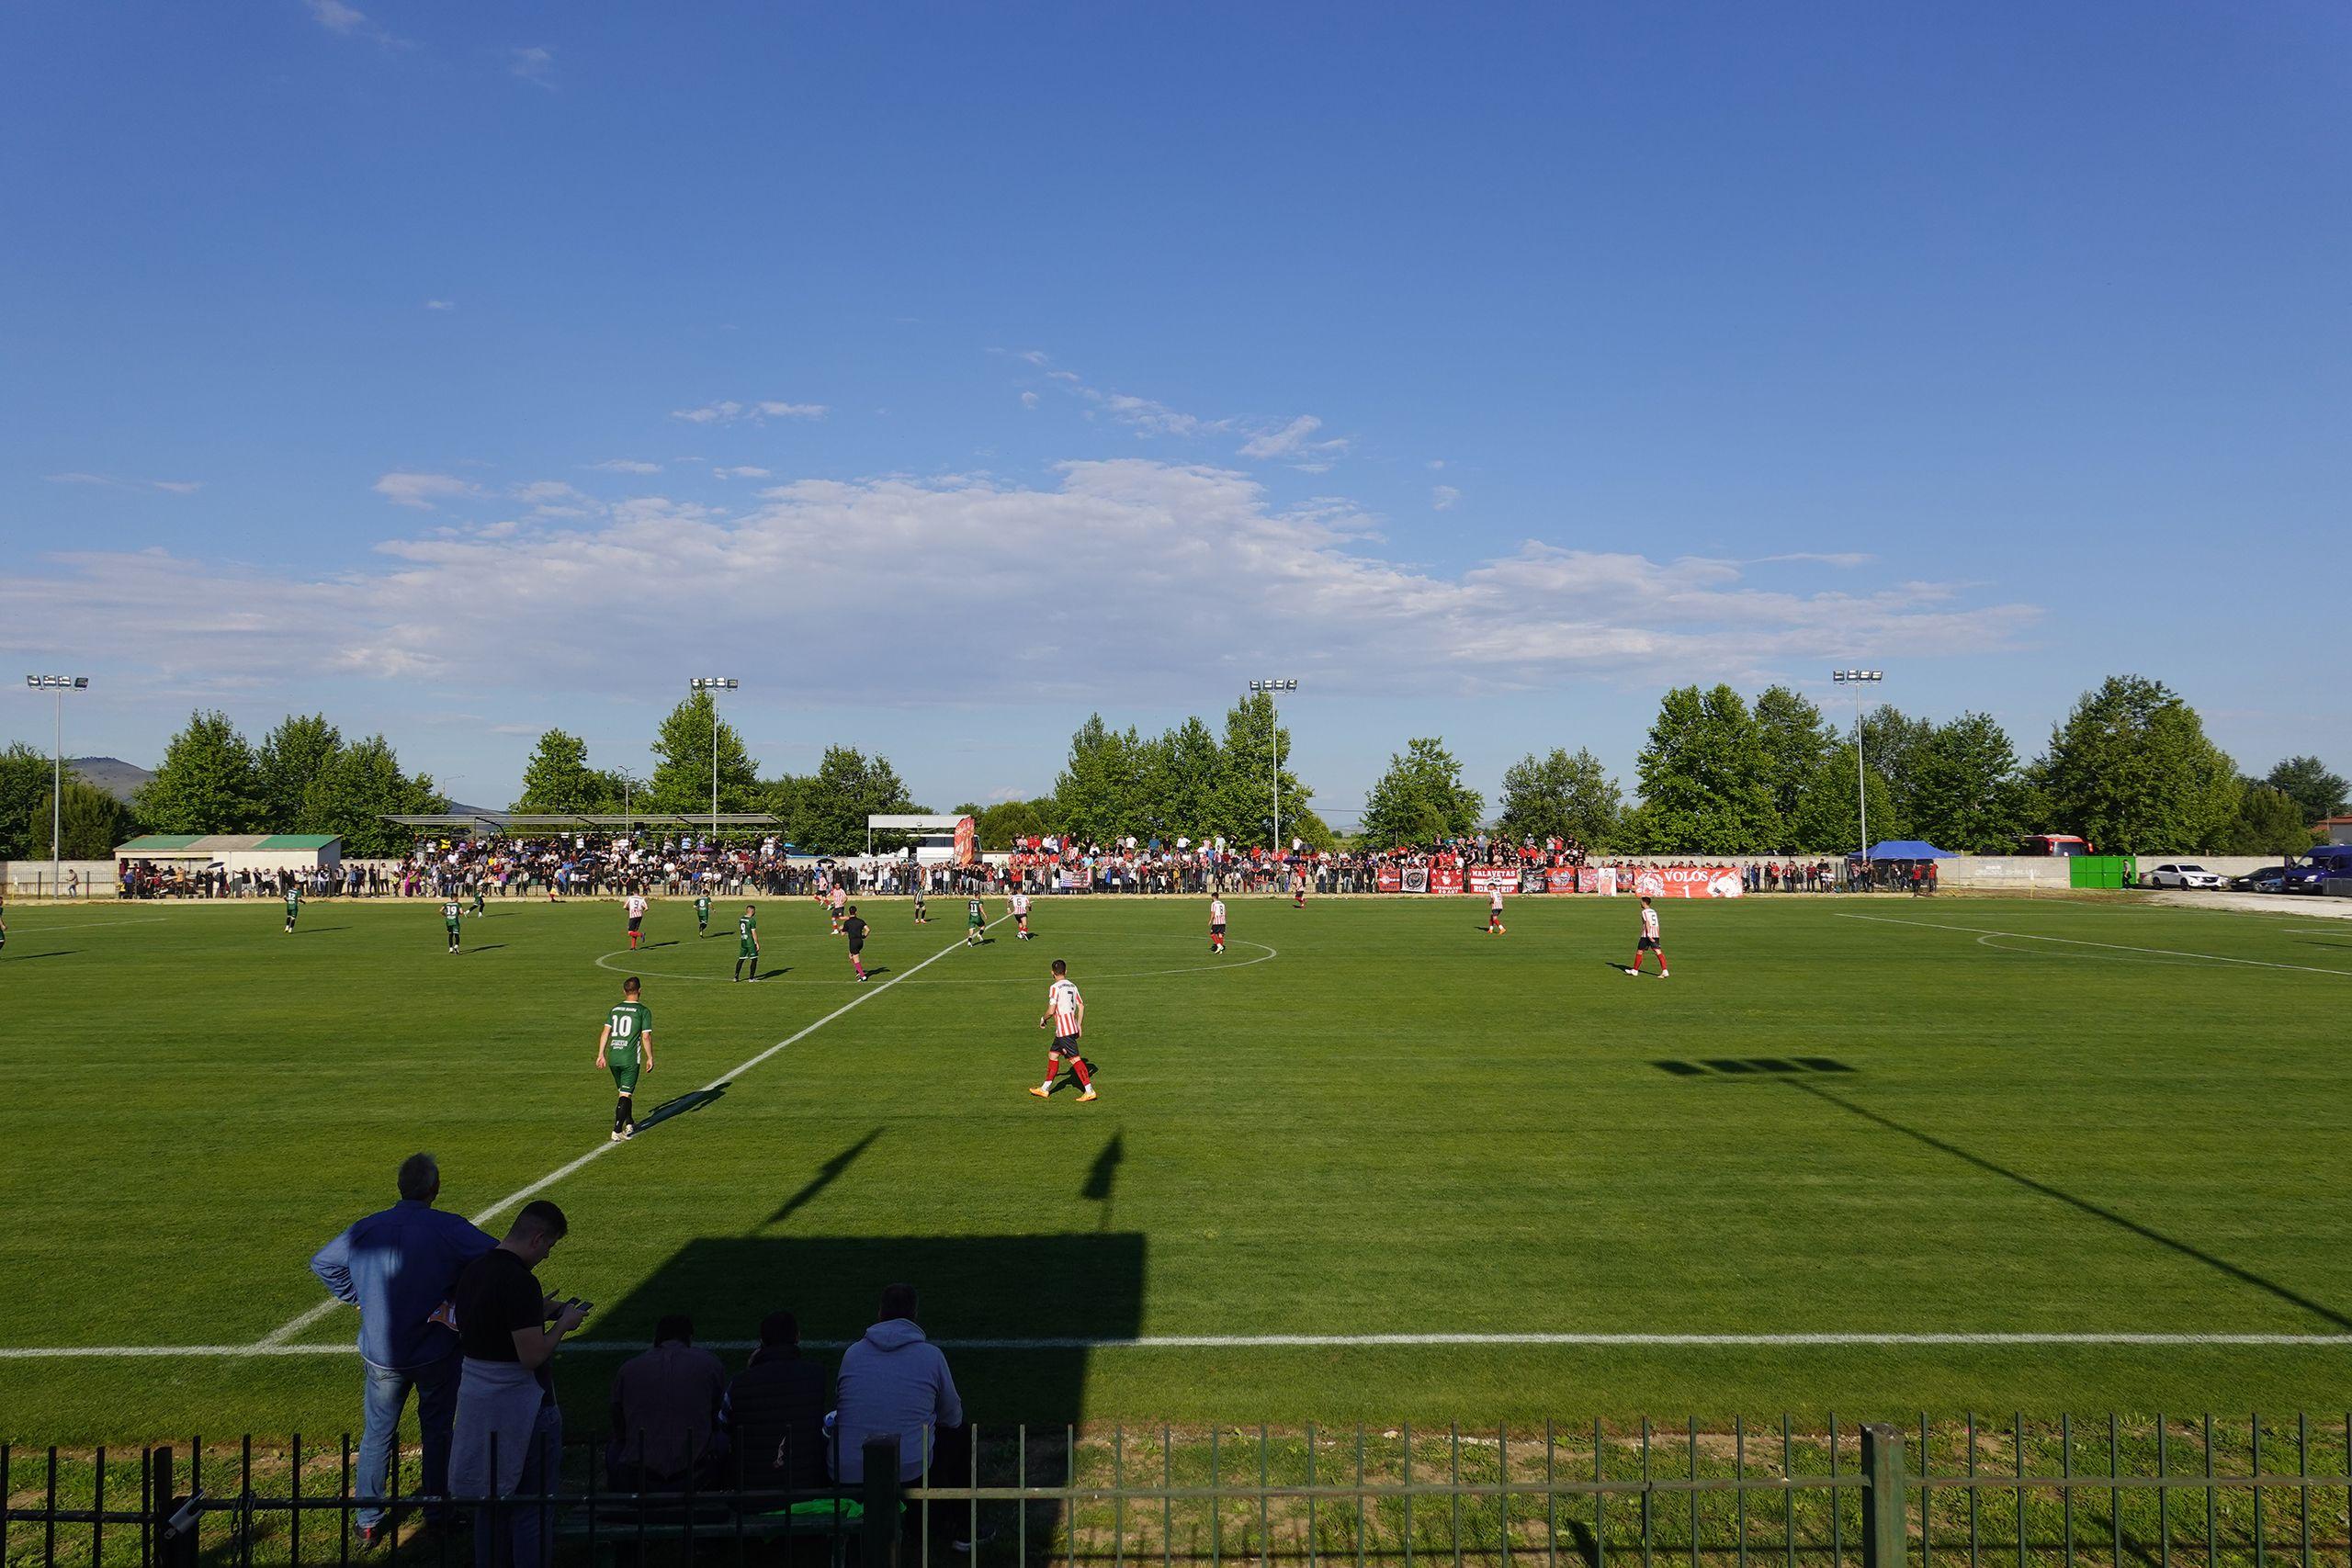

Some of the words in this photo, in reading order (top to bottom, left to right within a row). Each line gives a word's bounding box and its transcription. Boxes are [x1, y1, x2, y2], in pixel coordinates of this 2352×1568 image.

[1664, 871, 1708, 882] VOLOS
[288, 892, 296, 900] 12
[1682, 885, 1690, 898] 1
[699, 899, 706, 908] 8
[970, 903, 978, 912] 11
[446, 906, 458, 915] 19
[611, 1014, 632, 1037] 10
